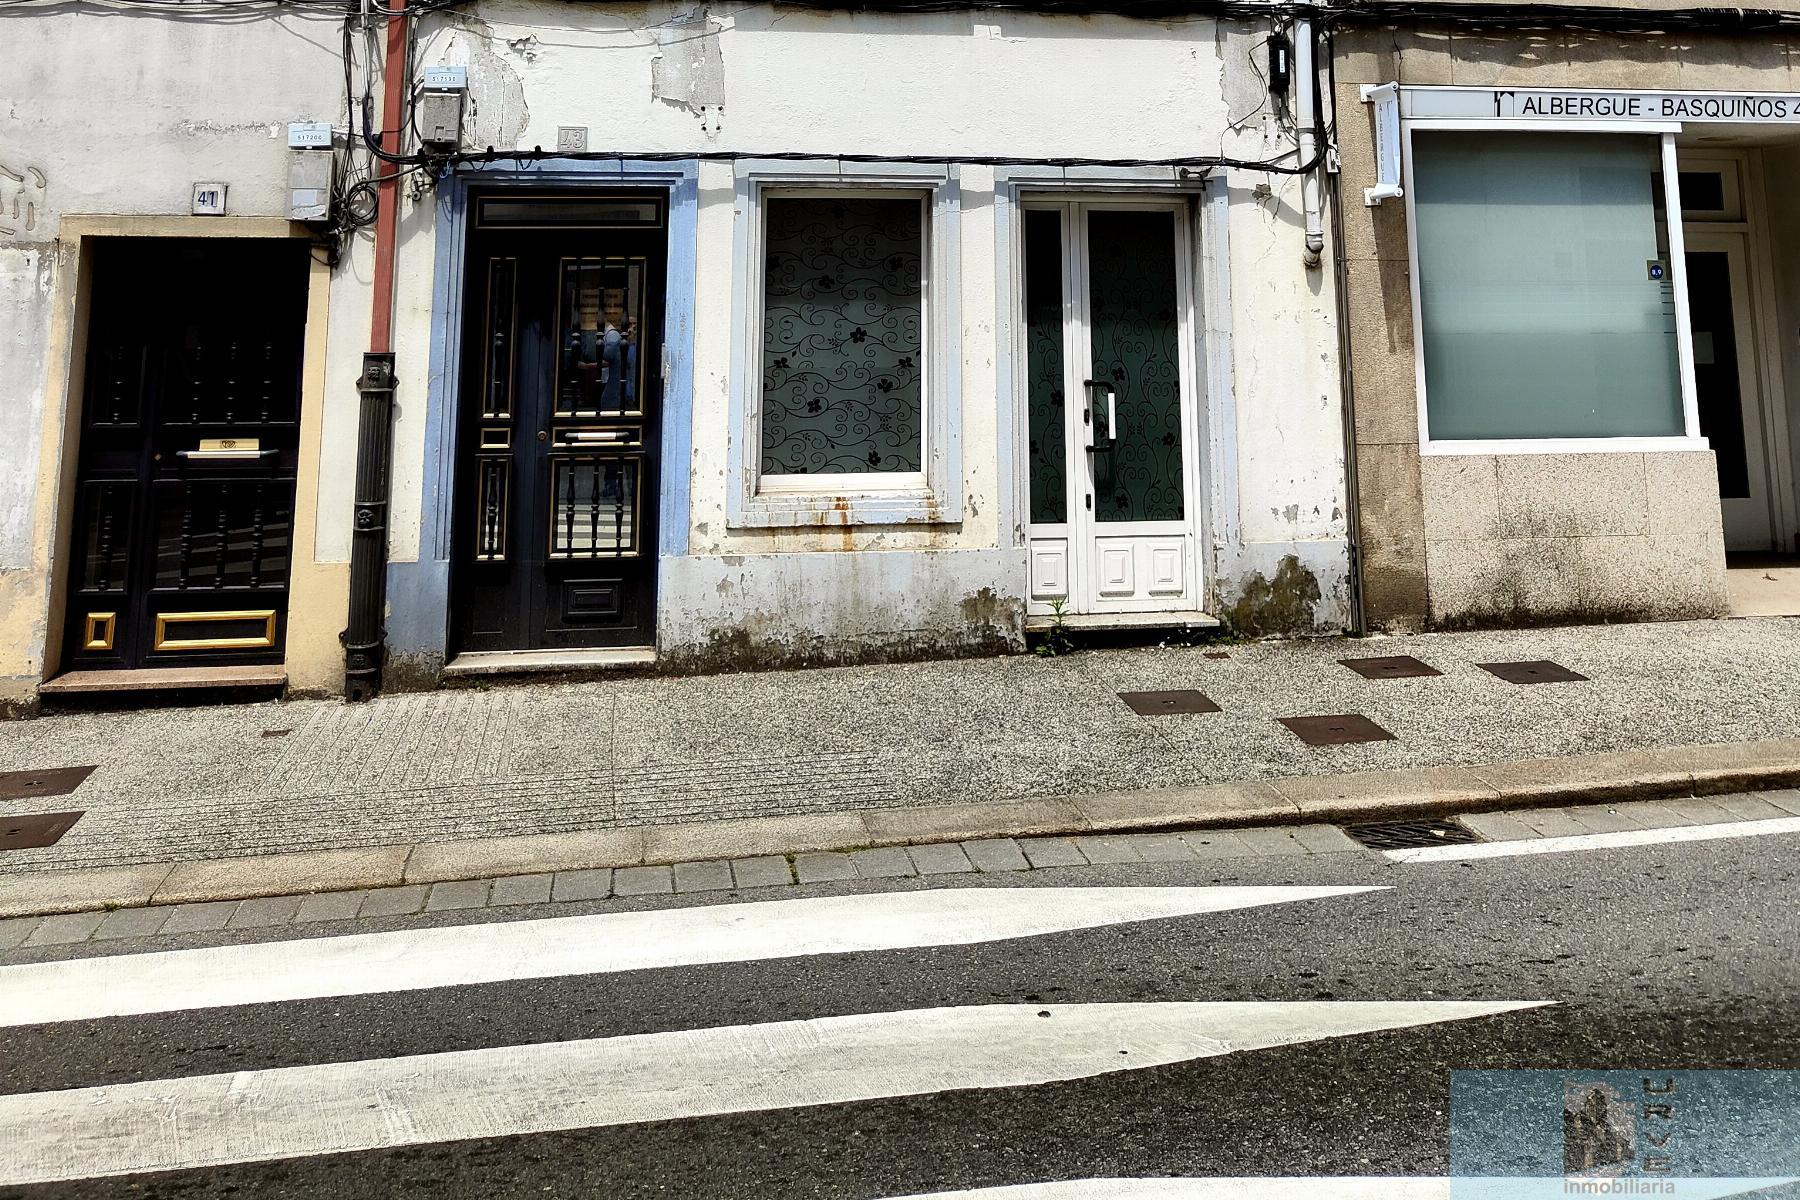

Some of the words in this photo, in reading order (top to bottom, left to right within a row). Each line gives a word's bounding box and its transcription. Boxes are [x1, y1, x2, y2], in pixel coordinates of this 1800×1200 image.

[1522, 96, 1641, 116] ALBERGUE
[1661, 96, 1787, 118] BASQUIÑOS
[197, 191, 217, 206] 41
